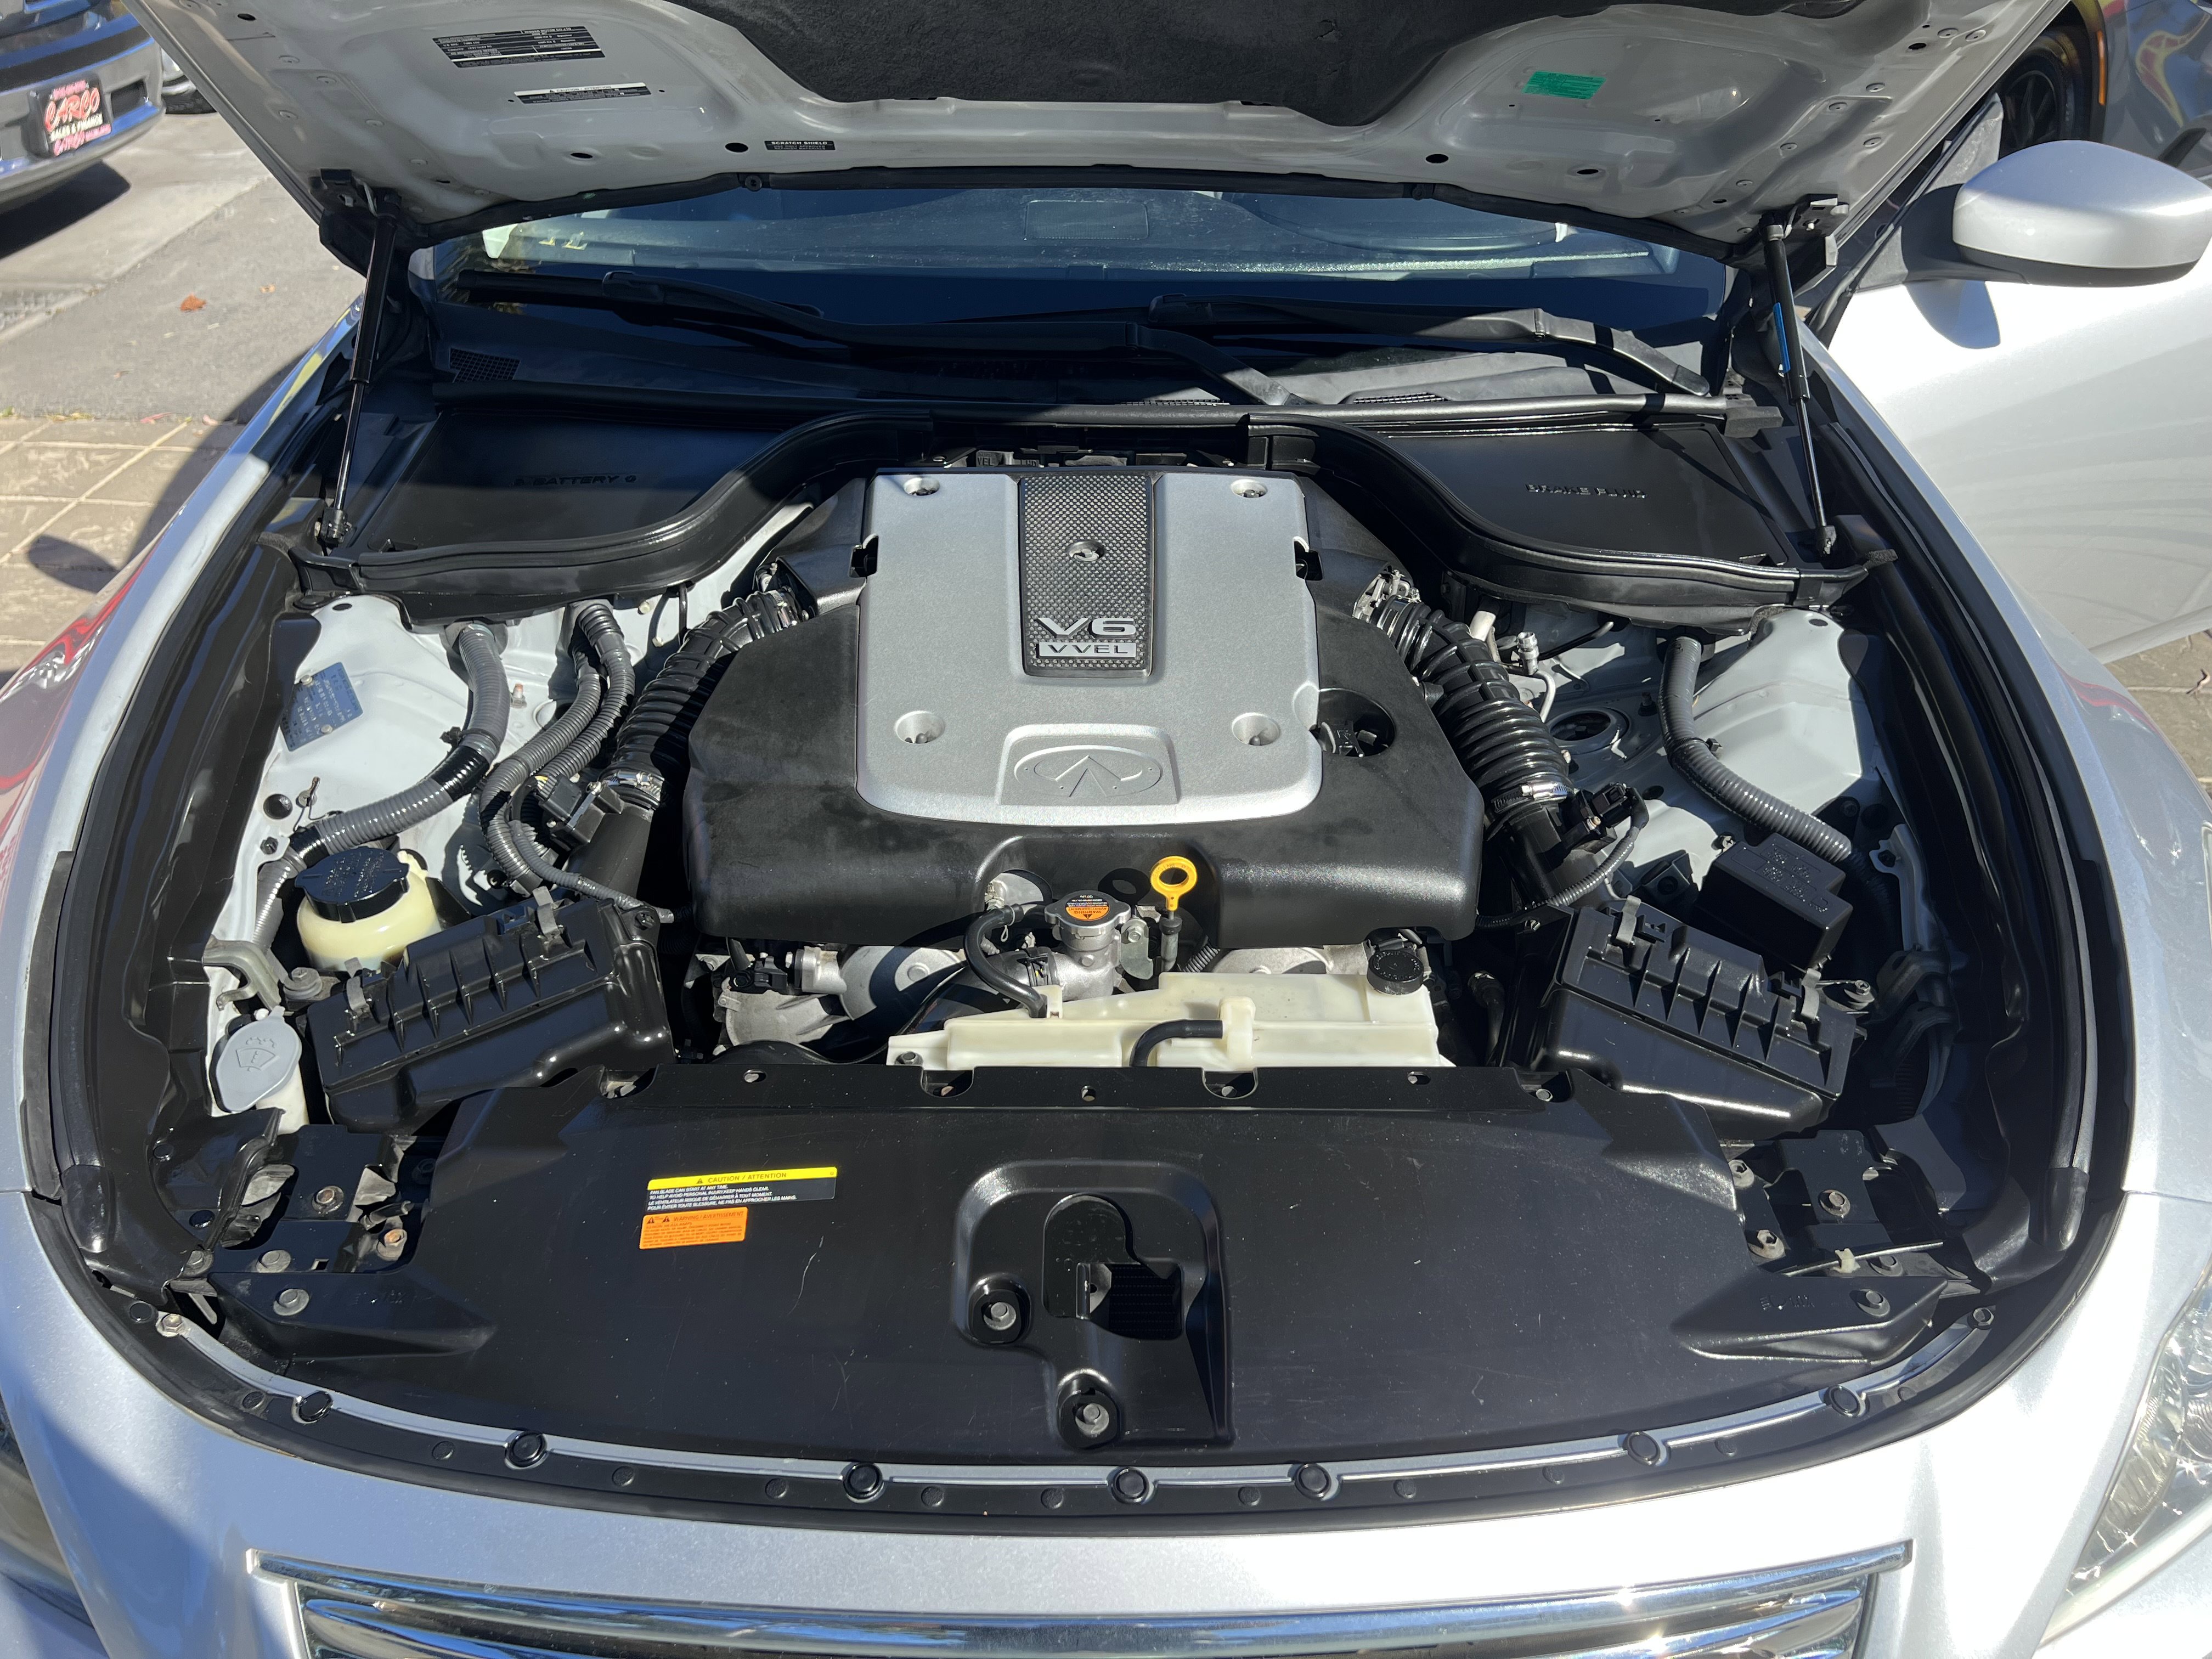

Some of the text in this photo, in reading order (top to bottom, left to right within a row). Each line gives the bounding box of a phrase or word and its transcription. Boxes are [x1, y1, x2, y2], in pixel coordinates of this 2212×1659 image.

[45, 87, 100, 132] CARCO
[532, 475, 620, 486] BATTERY
[1525, 483, 1648, 499] BRAKE FLUID
[1036, 617, 1137, 639] V6
[1047, 644, 1129, 654] VVEL
